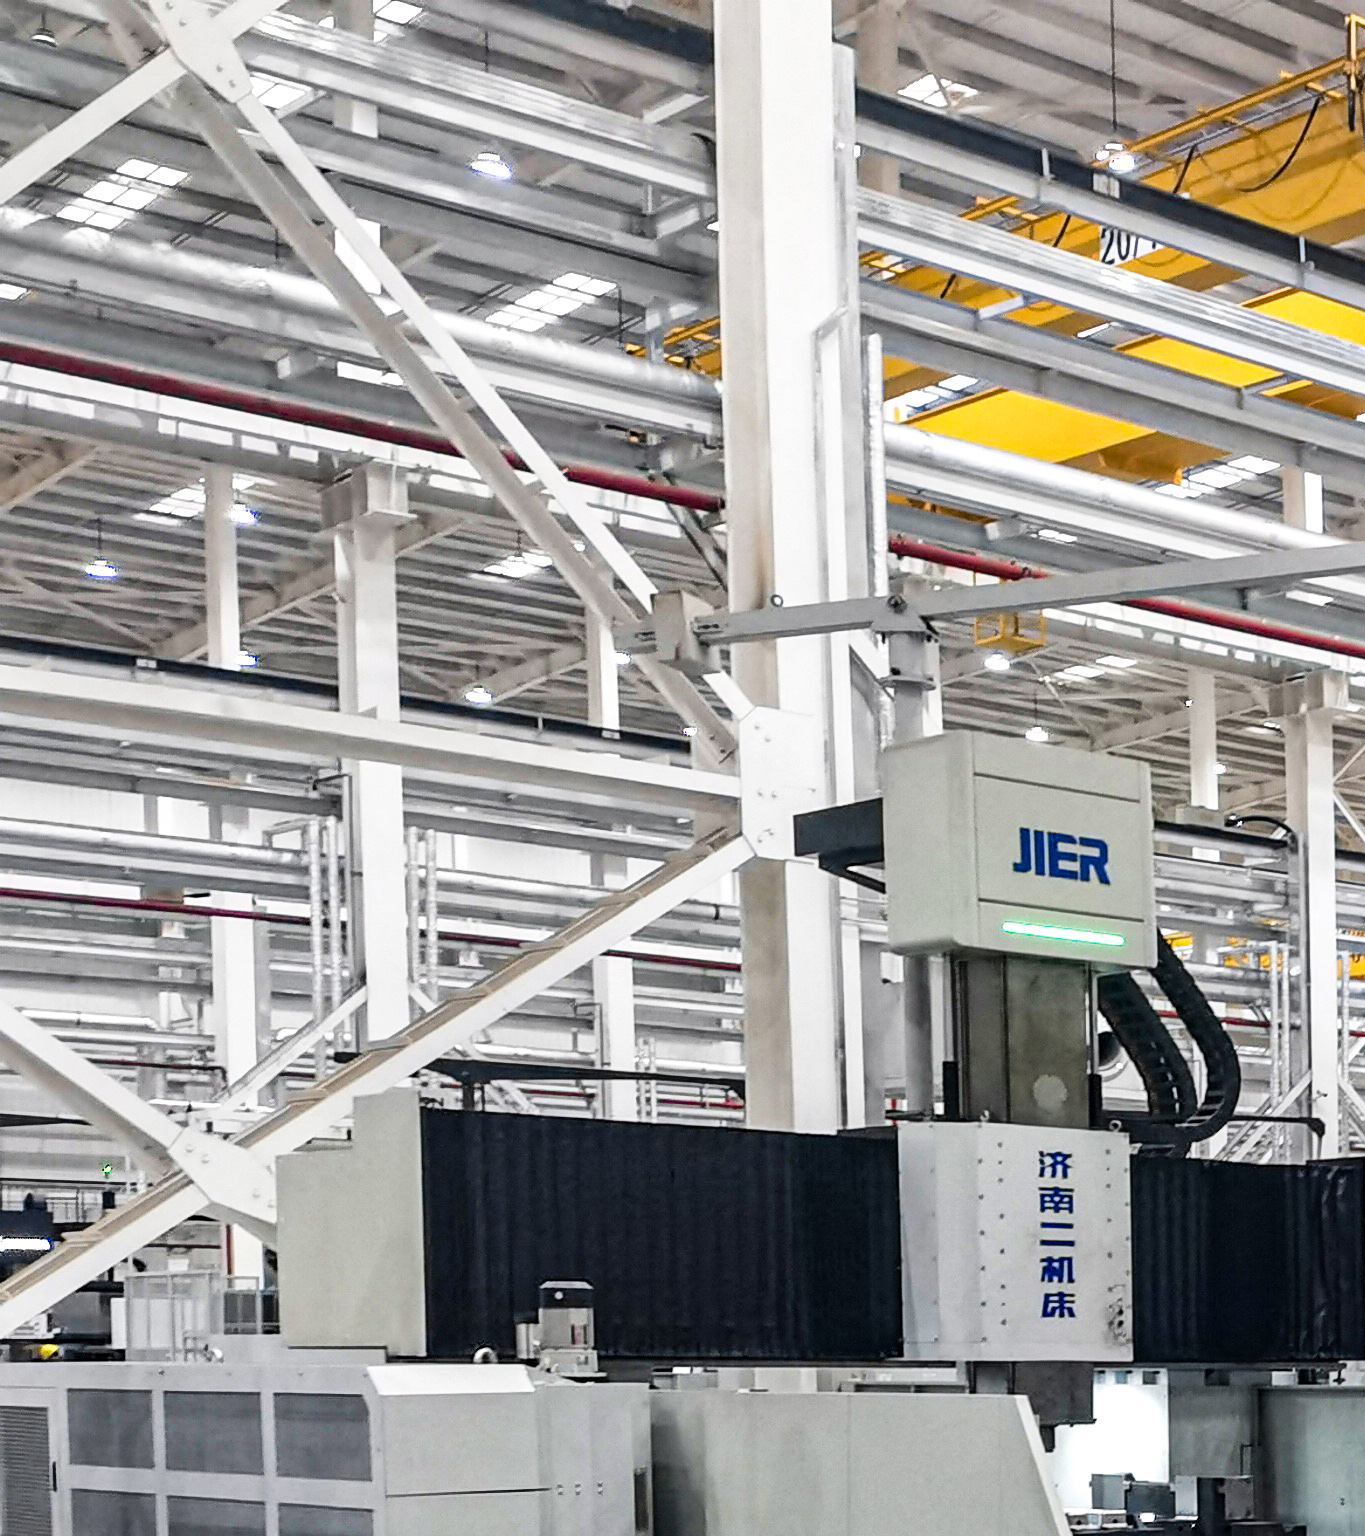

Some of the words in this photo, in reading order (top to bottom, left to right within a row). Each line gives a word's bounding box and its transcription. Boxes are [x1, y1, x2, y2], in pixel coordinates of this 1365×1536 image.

[1012, 827, 1111, 886] JIER
[1038, 1151, 1076, 1318] 济南二机床
